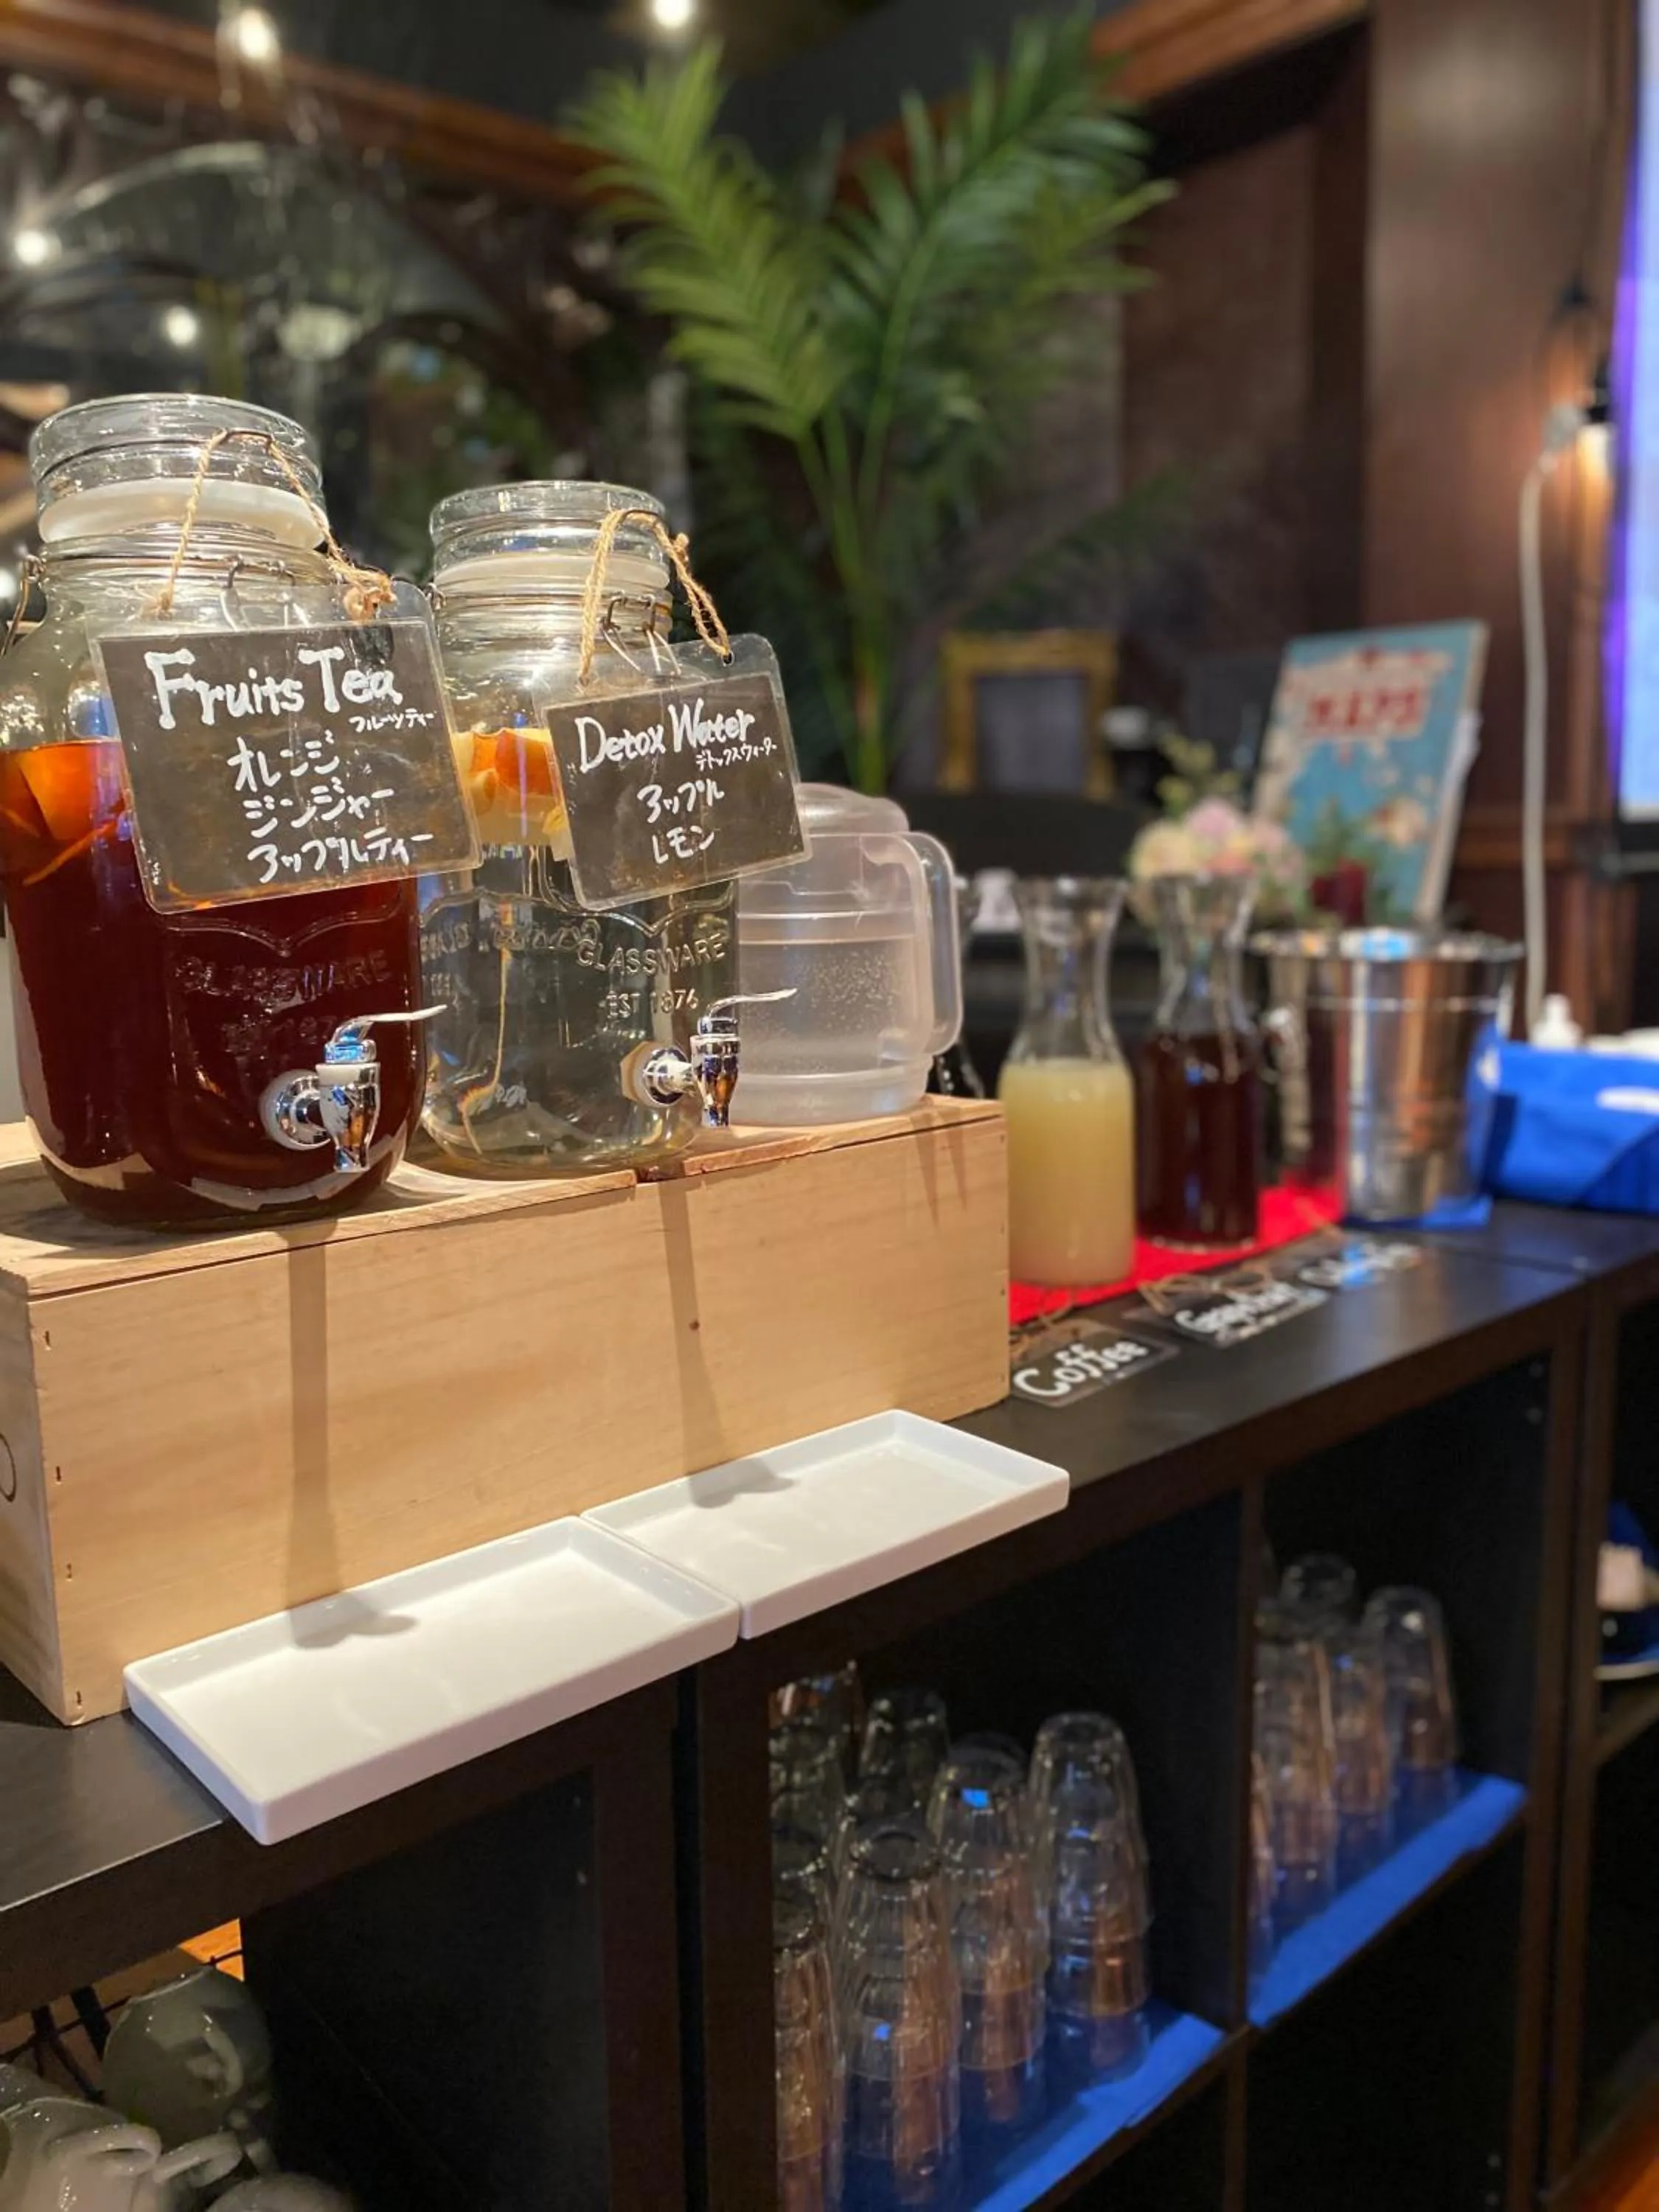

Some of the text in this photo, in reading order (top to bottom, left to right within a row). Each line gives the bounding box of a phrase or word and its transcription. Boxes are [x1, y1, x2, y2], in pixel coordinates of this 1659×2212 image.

[145, 647, 403, 729] Fruits Tea
[348, 708, 436, 733] フルーツティー
[574, 698, 756, 773] Detox Water
[226, 730, 341, 792] オレンジ
[243, 777, 394, 838] ジンジャー
[636, 778, 725, 824] アップル
[247, 827, 434, 884] アップルティー
[651, 824, 715, 864] レモン
[576, 933, 726, 975] GLASSWARE
[605, 990, 641, 1018] EST
[1012, 1338, 1150, 1397] Coffee
